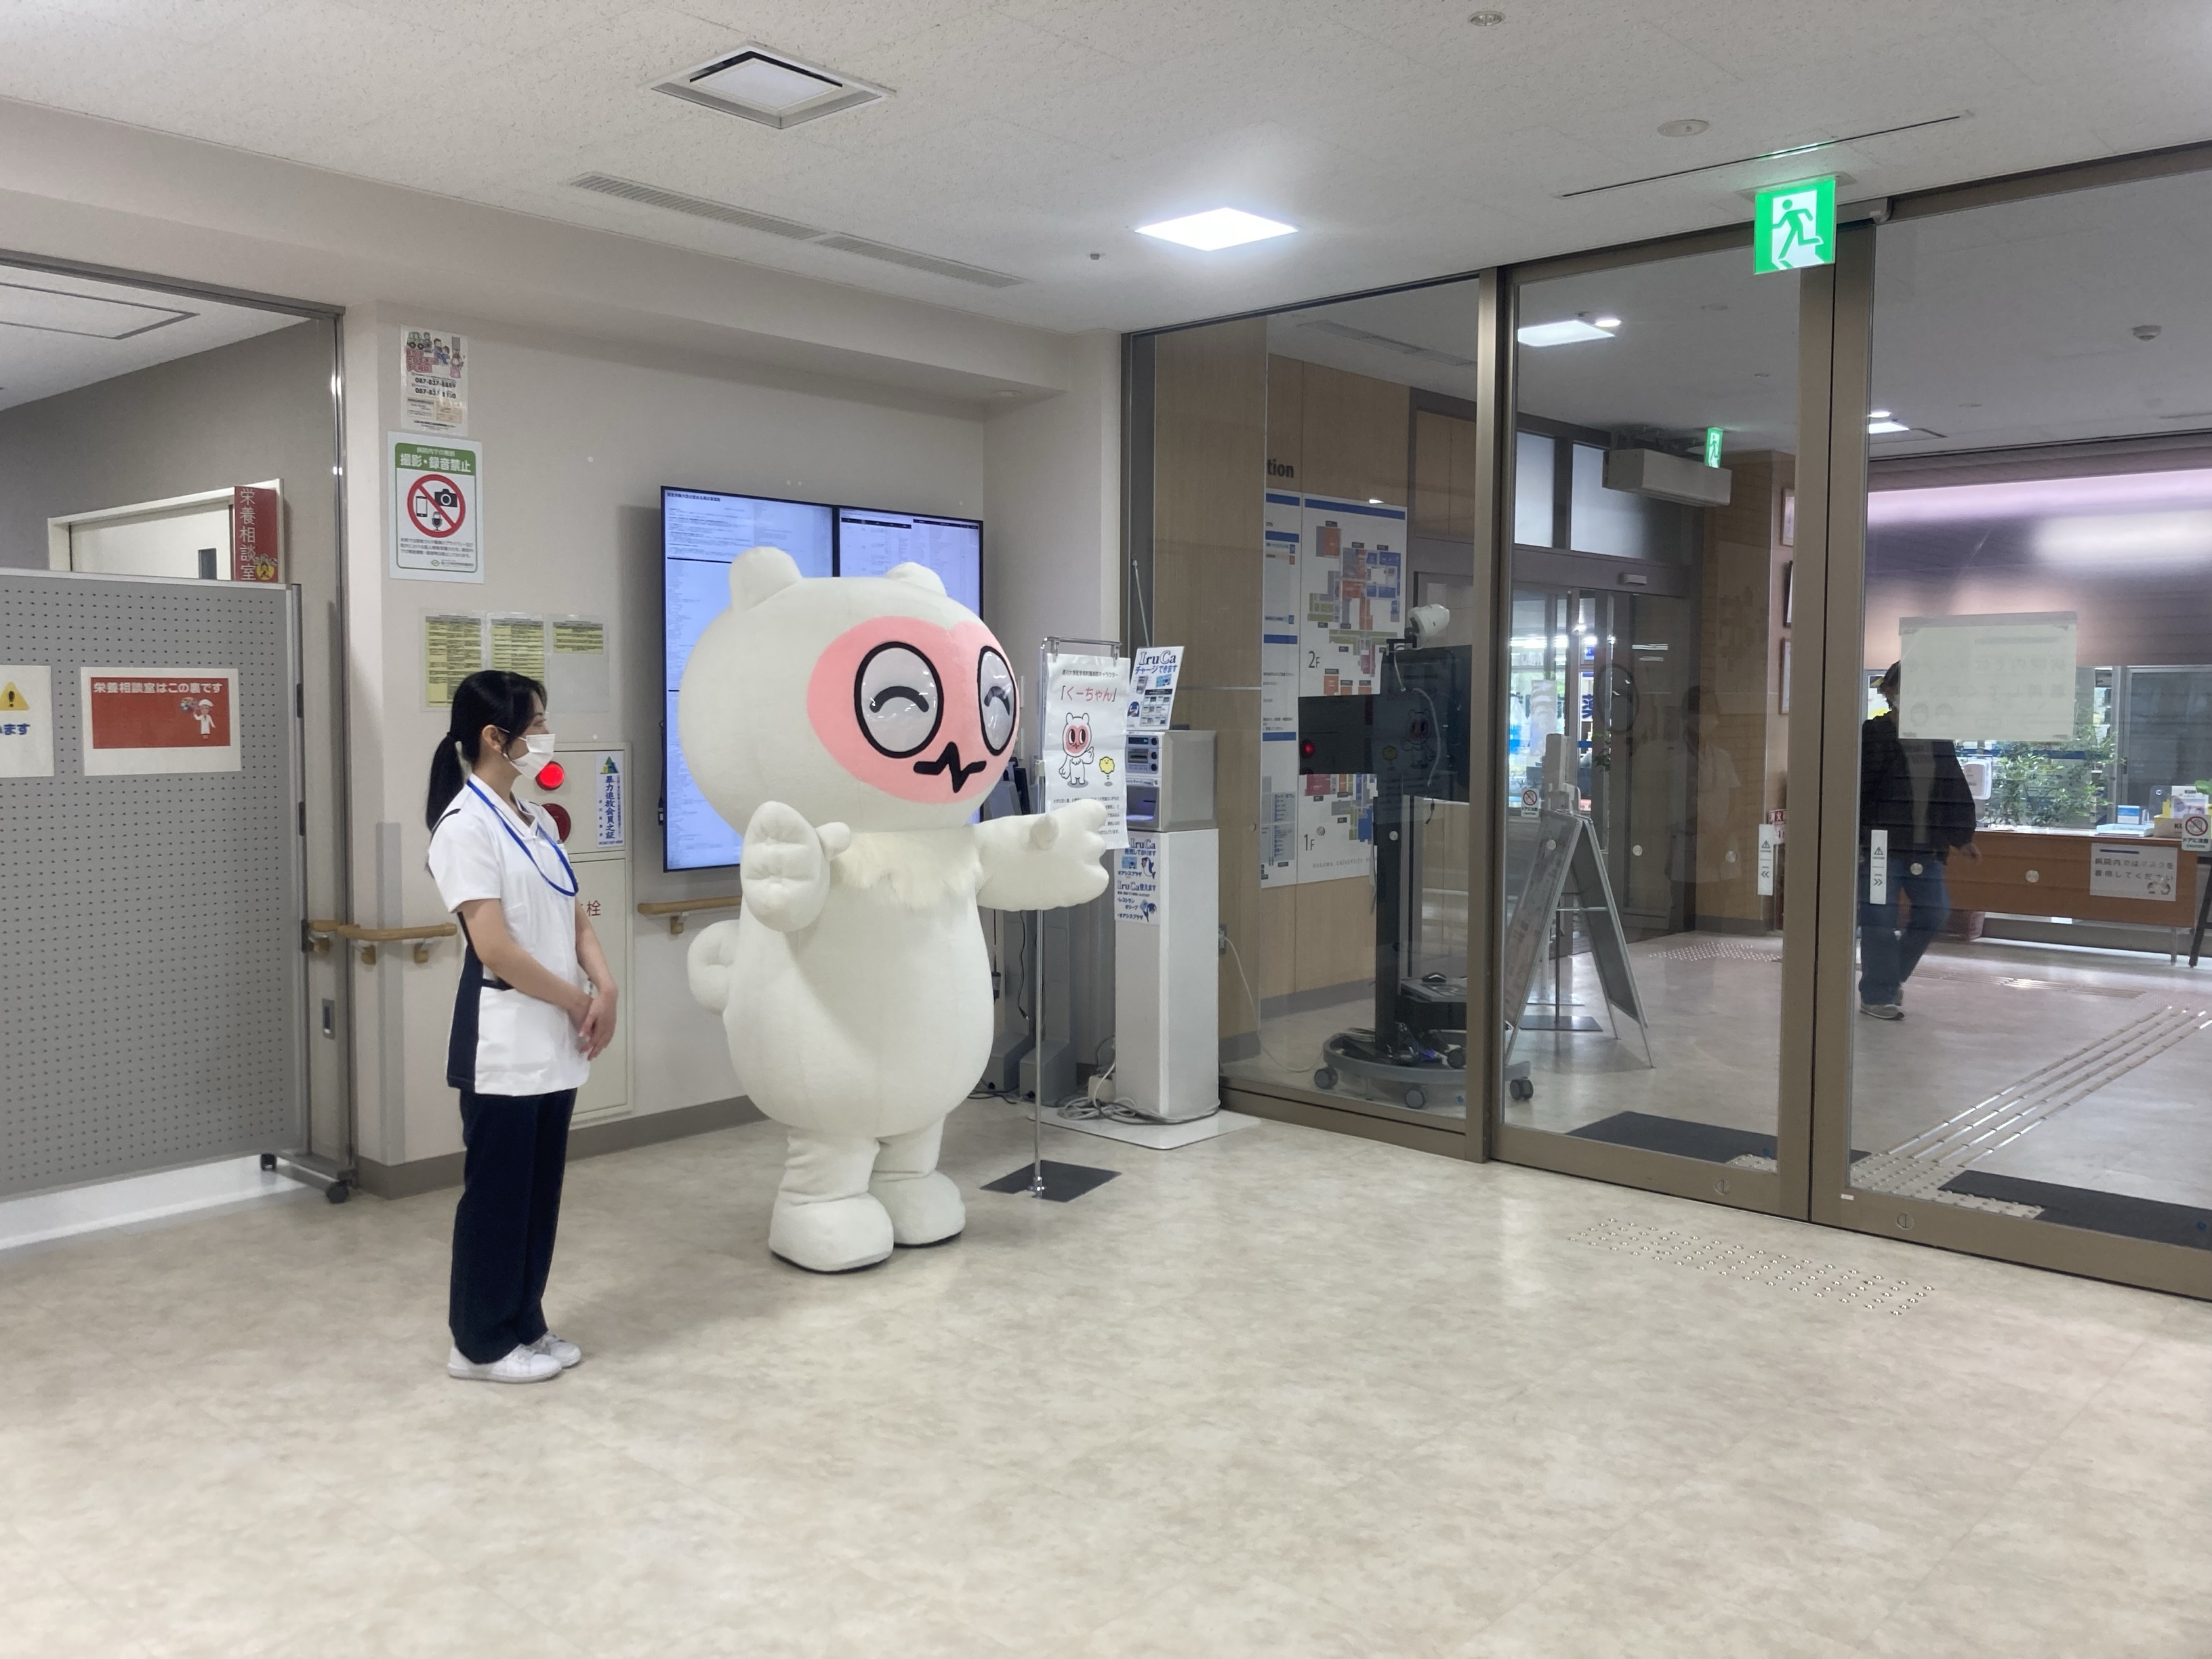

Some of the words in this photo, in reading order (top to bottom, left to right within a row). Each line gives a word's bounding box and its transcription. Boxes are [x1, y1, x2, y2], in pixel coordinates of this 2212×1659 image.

[401, 453, 471, 472] 撮影・録音禁止
[1267, 459, 1294, 478] tion
[239, 488, 256, 581] 栄養相談室
[1139, 650, 1176, 665] IruCa
[1308, 651, 1320, 668] 2F
[1135, 665, 1178, 674] チャージできます
[94, 682, 222, 693] 栄養相談室はこの裏です
[1061, 685, 1117, 702] 「くーちゃん」
[1130, 838, 1156, 849] IruCa
[1304, 834, 1315, 851] 1F
[580, 900, 601, 916] 栓
